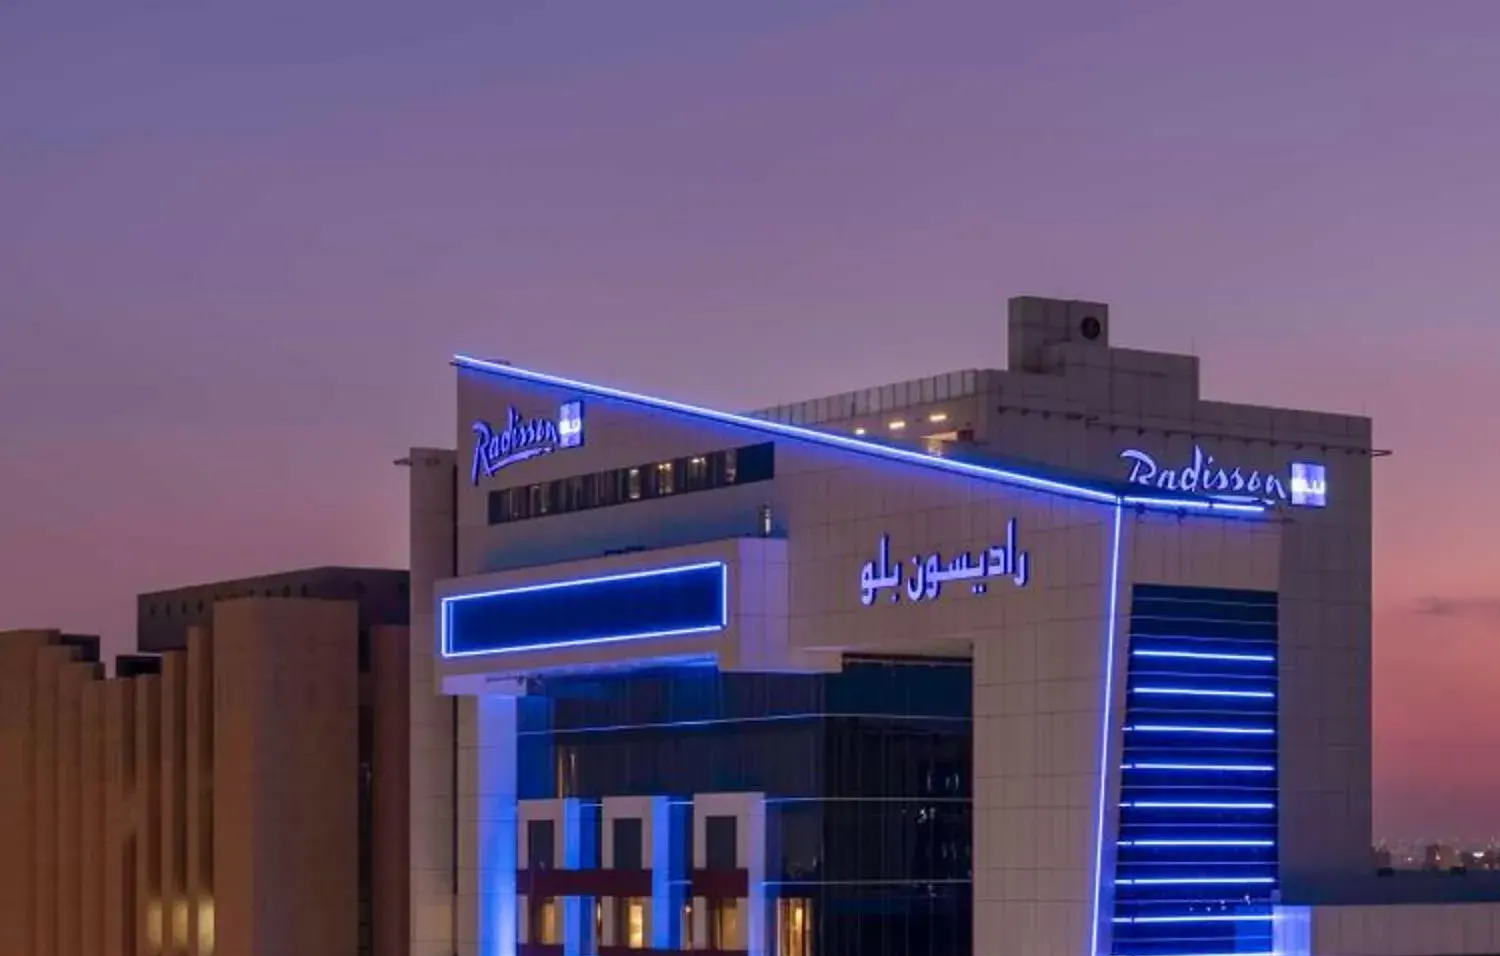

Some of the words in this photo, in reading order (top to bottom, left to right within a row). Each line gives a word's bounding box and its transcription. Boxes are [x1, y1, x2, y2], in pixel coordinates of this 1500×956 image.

[471, 405, 557, 485] Radisson
[1120, 444, 1286, 504] Radisson
[861, 532, 902, 606] بلو
[908, 517, 1028, 601] راديسون
